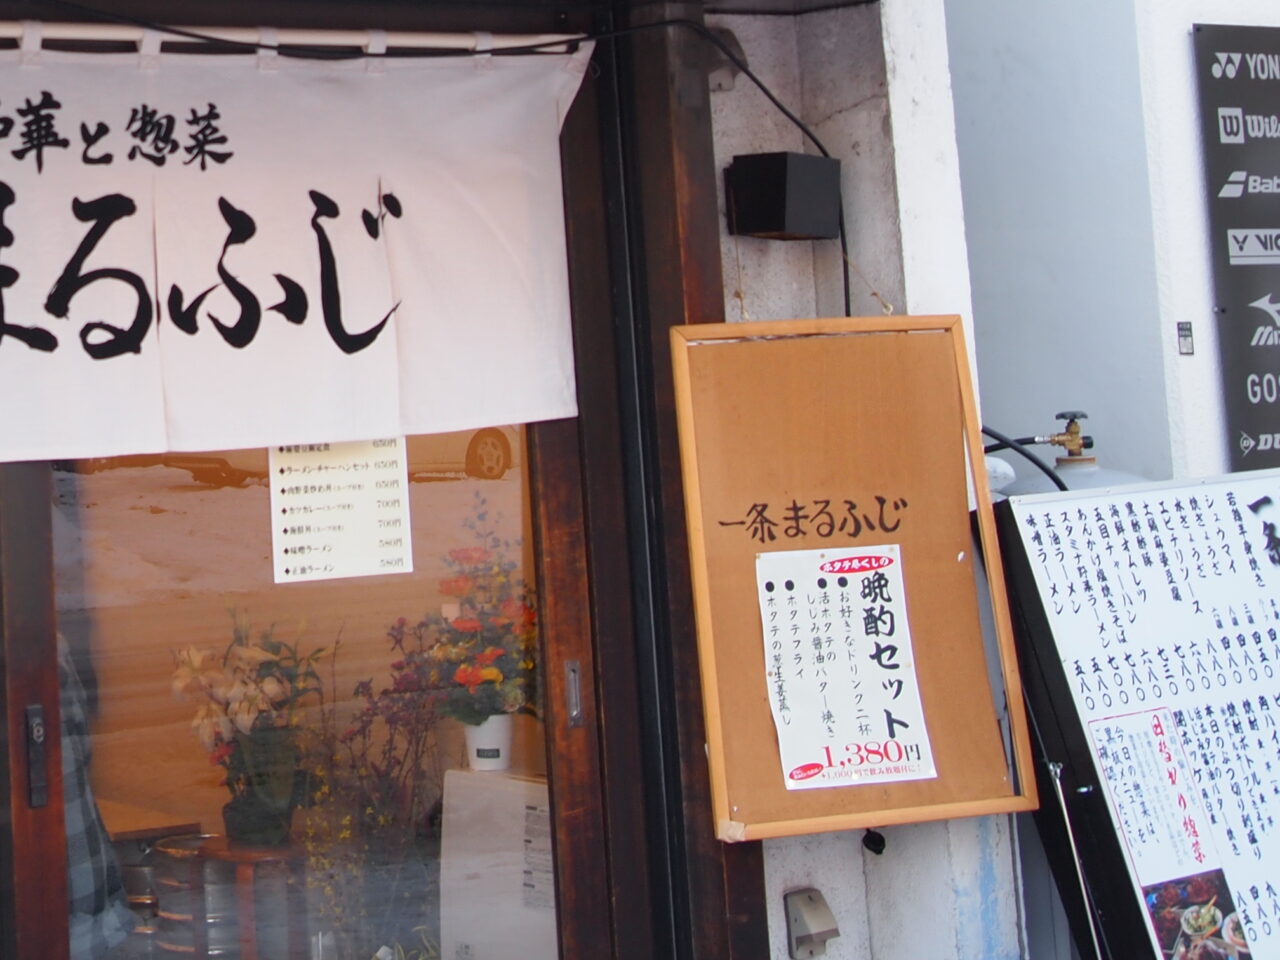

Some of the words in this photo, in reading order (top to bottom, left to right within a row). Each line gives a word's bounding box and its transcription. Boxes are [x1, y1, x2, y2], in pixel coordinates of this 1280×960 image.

[1245, 115, 1280, 138] Wil
[1247, 373, 1280, 403] GO
[718, 495, 908, 543] 一条まるふじ
[787, 595, 804, 679] ホタテフライ
[860, 570, 909, 739] 晩酌セット
[822, 739, 921, 769] 1,380円
